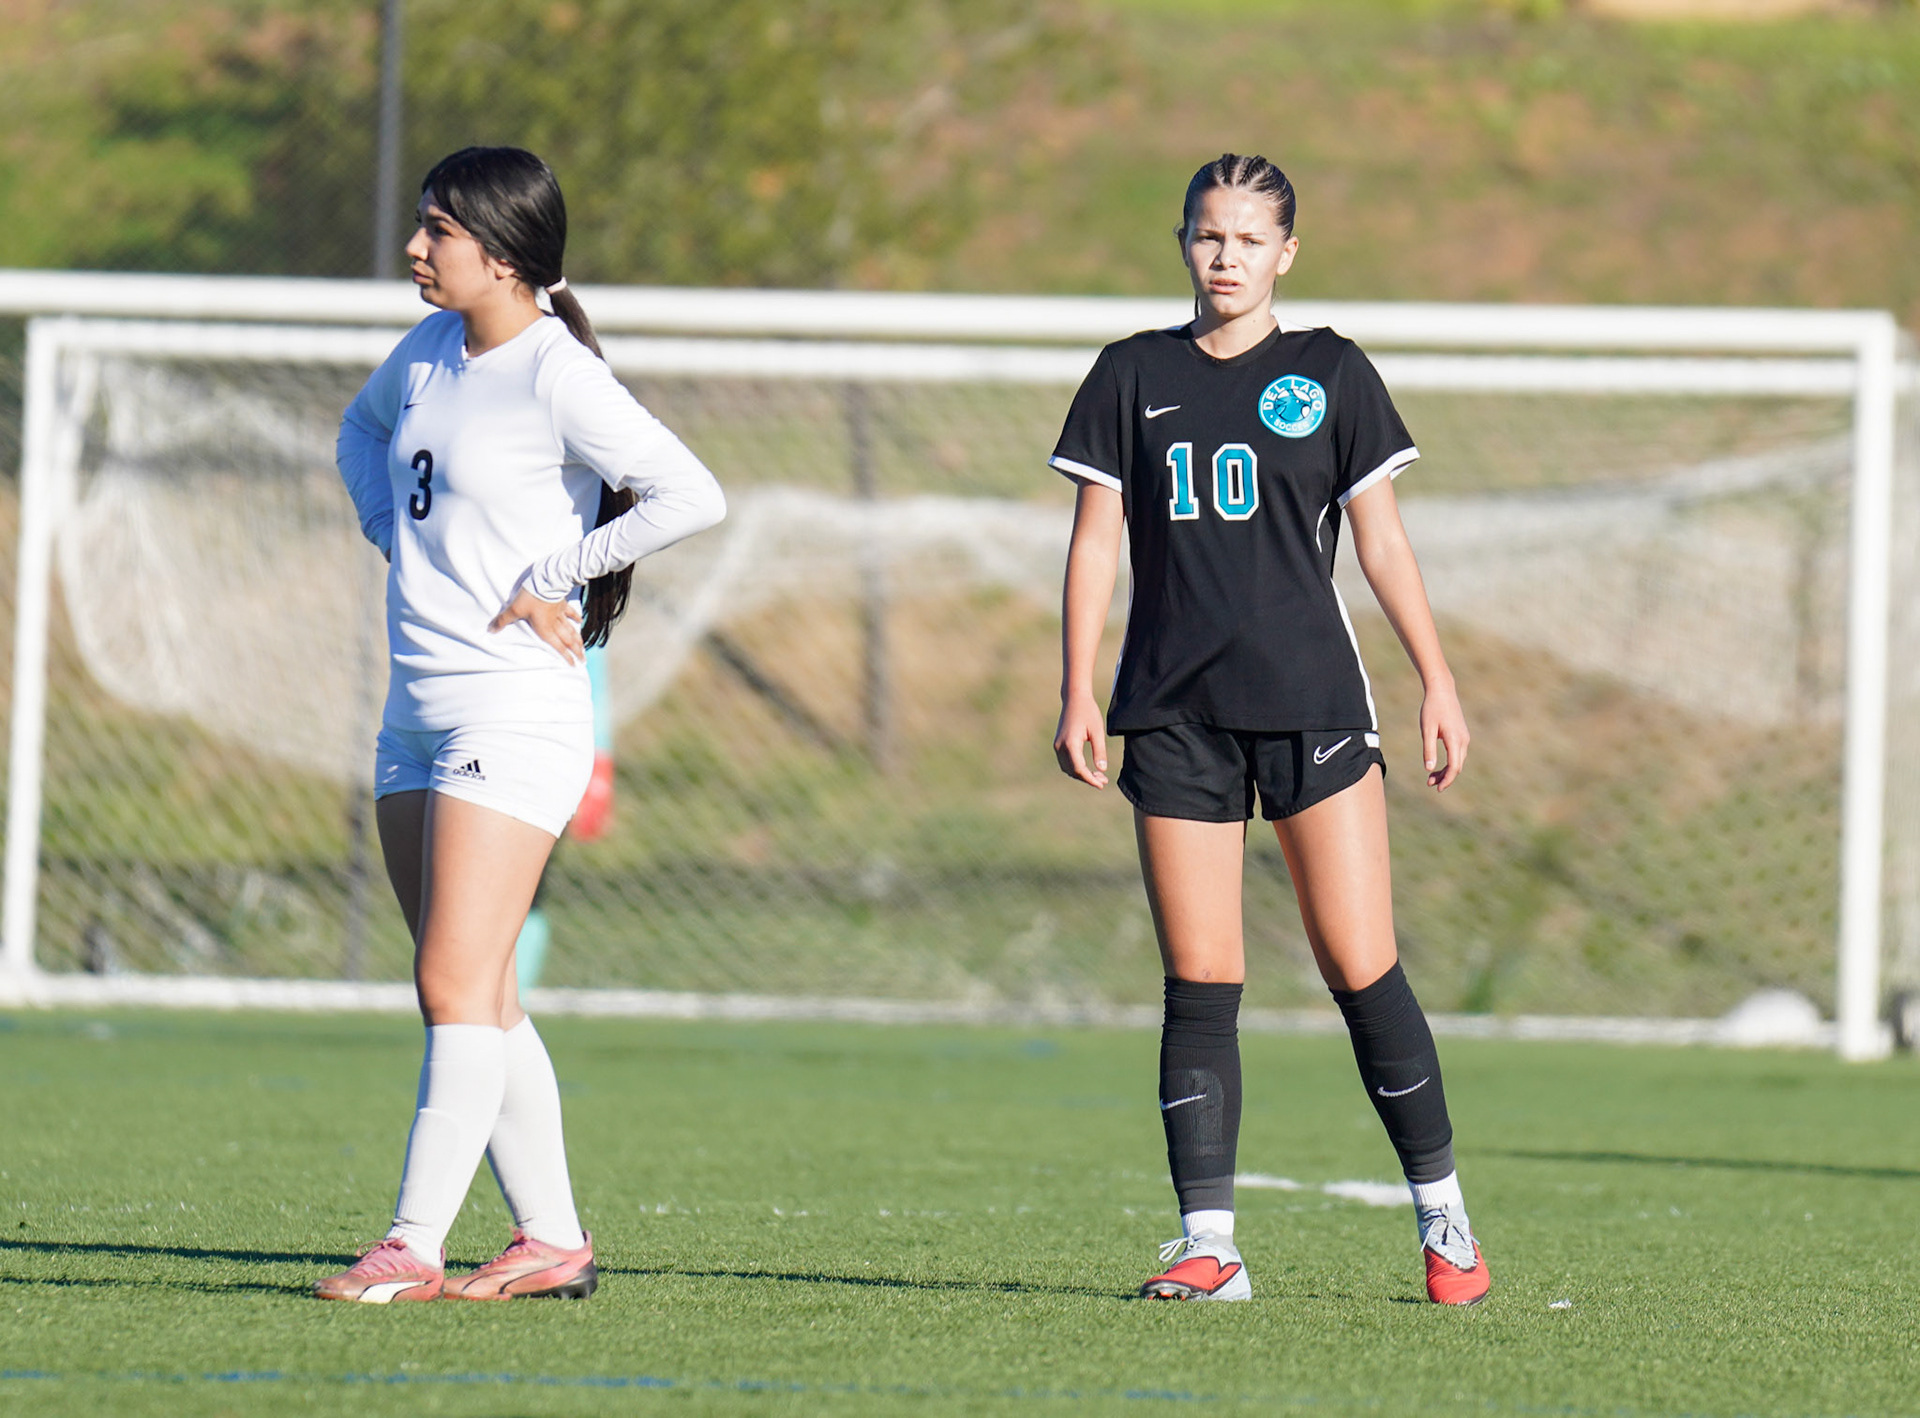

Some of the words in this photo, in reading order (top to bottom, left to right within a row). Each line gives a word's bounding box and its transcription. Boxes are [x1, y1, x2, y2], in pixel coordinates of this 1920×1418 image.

[1263, 384, 1285, 411] DEL
[1290, 379, 1322, 411] LAGO
[1273, 418, 1310, 432] SOCCER
[409, 449, 433, 521] 3
[1166, 442, 1260, 521] 10
[453, 768, 486, 781] adidas
